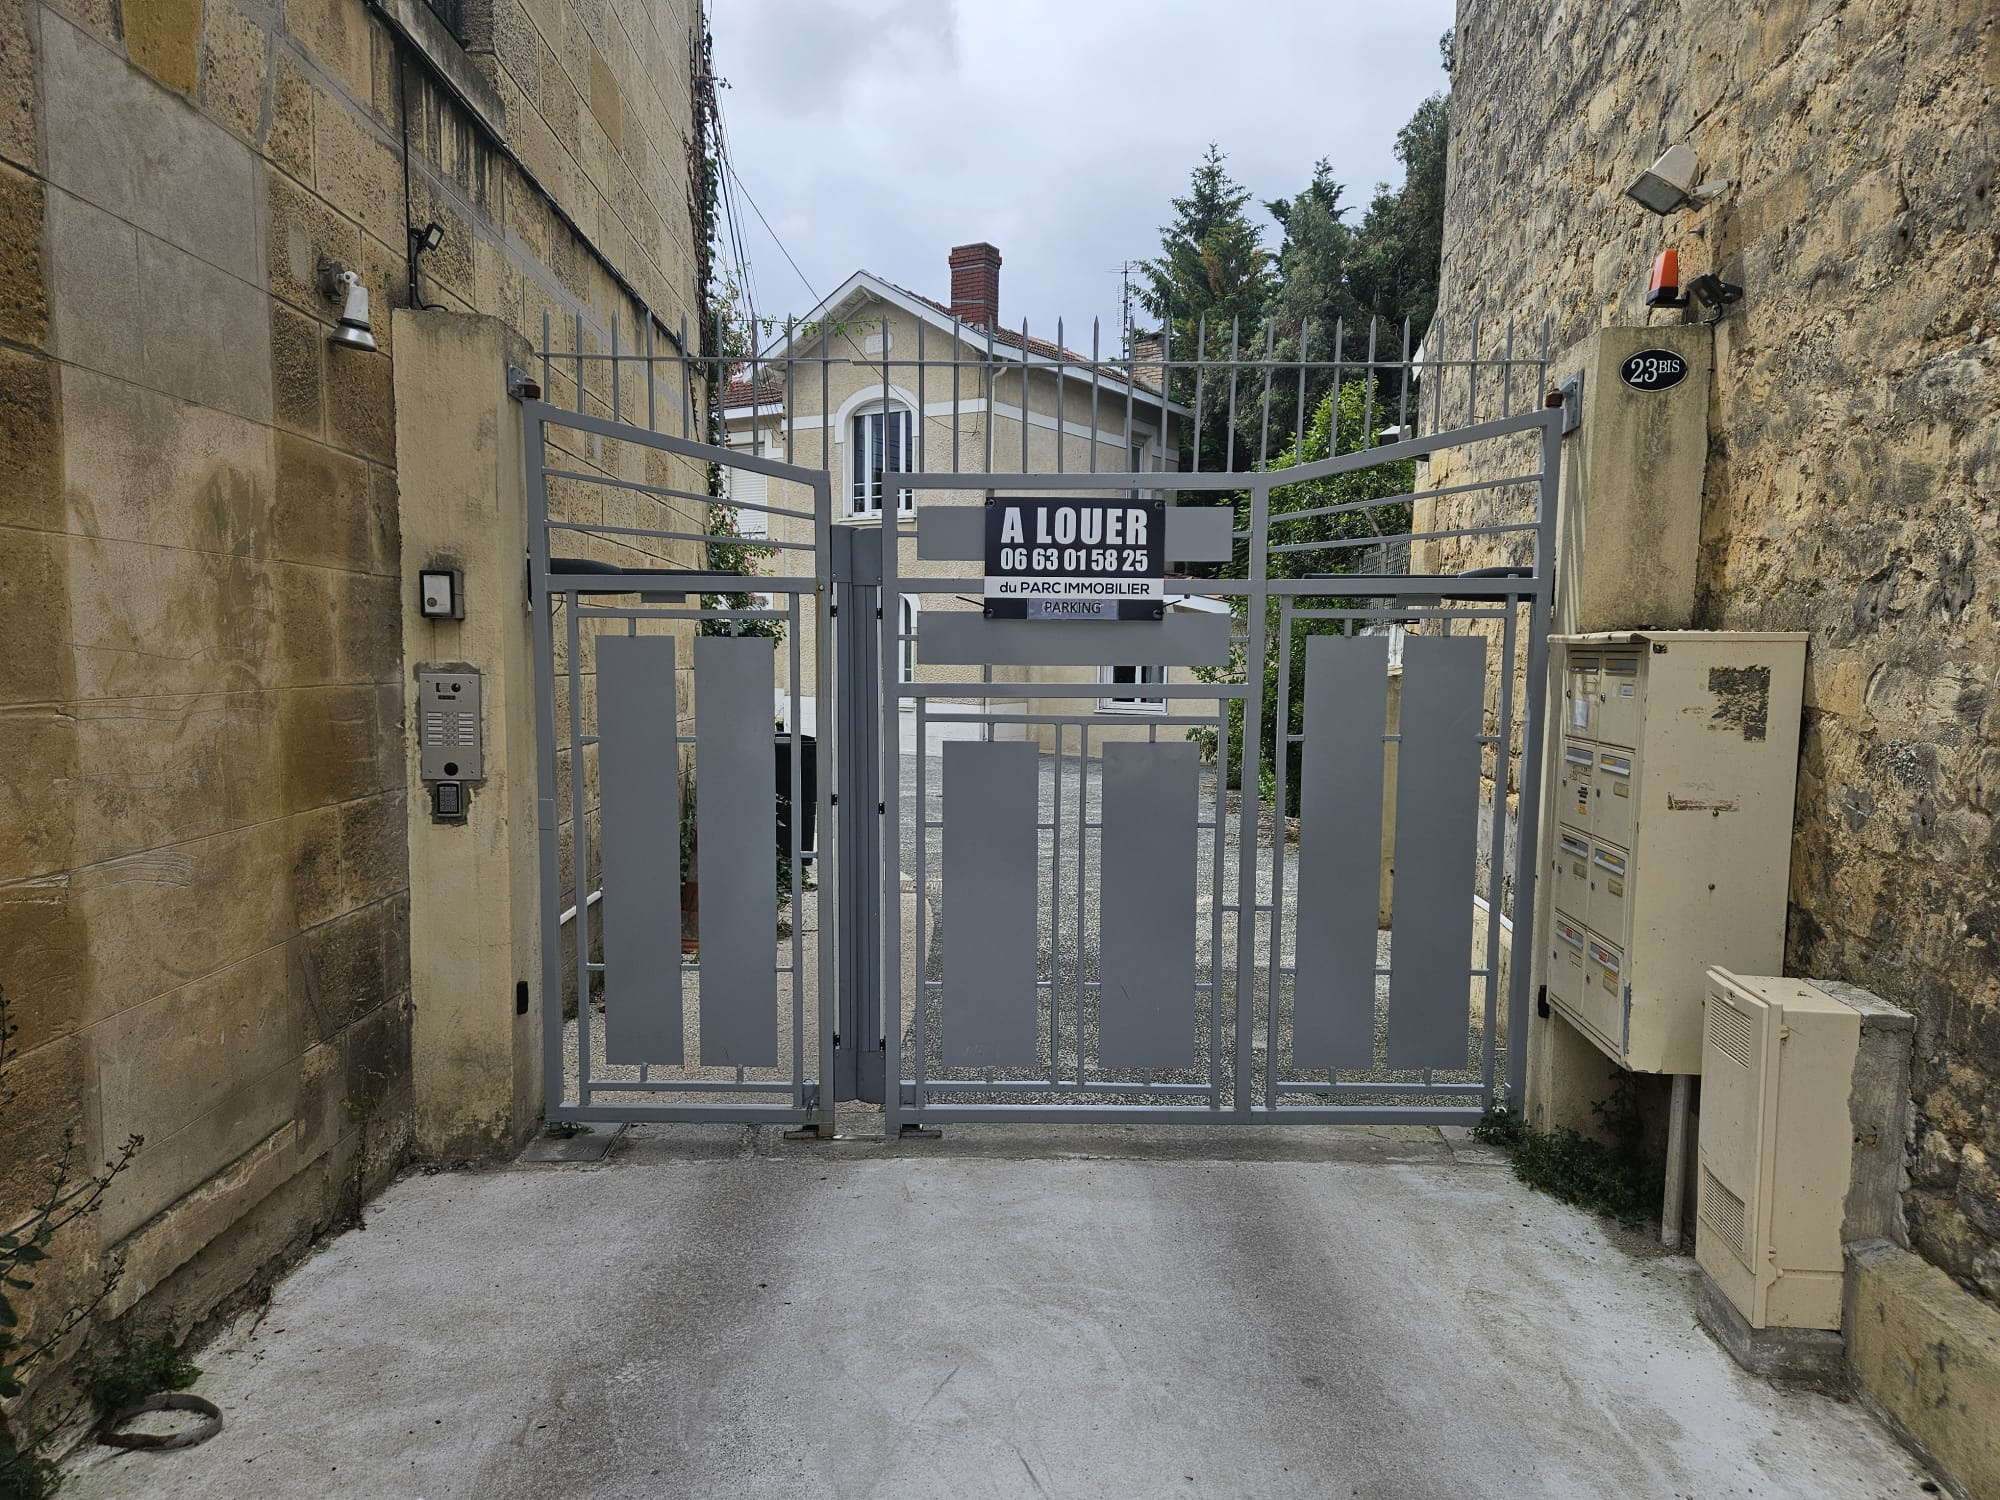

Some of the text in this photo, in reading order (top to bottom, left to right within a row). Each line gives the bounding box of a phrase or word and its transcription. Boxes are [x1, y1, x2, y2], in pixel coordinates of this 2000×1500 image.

[1000, 506, 1147, 545] A LOUER
[1000, 547, 1149, 572] 06 63 01 58 25
[999, 581, 1150, 595] du PARC IMMOBILIER
[1044, 601, 1101, 614] PARKING
